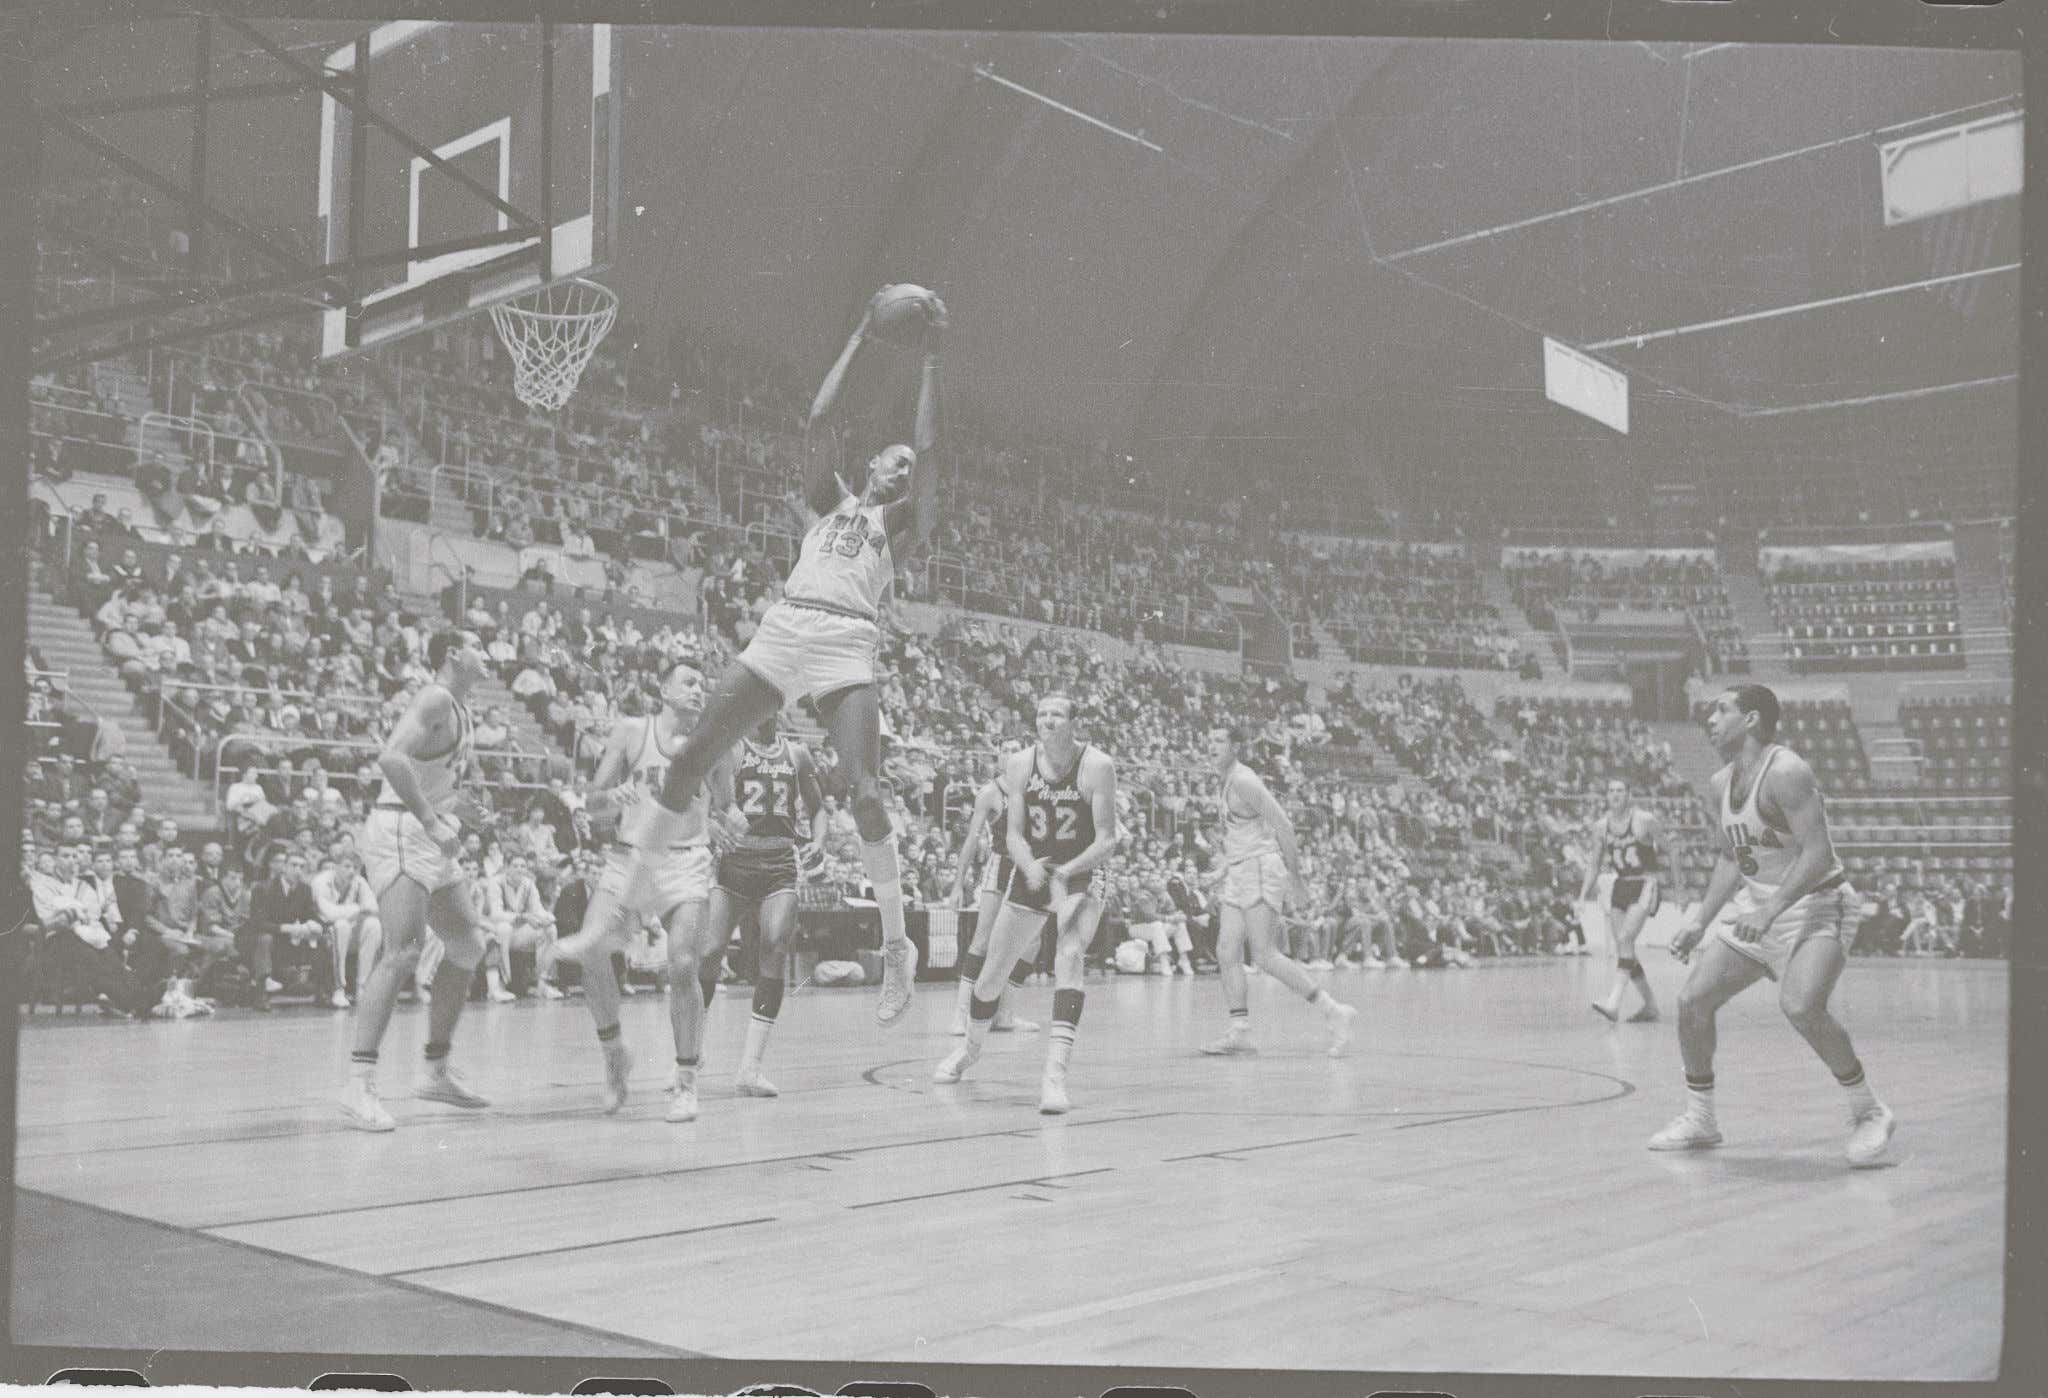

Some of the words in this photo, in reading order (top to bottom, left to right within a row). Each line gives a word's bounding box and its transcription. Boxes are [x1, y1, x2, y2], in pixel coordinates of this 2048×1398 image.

[819, 530, 863, 559] 13
[743, 780, 789, 816] 22
[1026, 773, 1045, 793] Los
[1038, 784, 1081, 807] Angeles
[1028, 805, 1077, 840] 32
